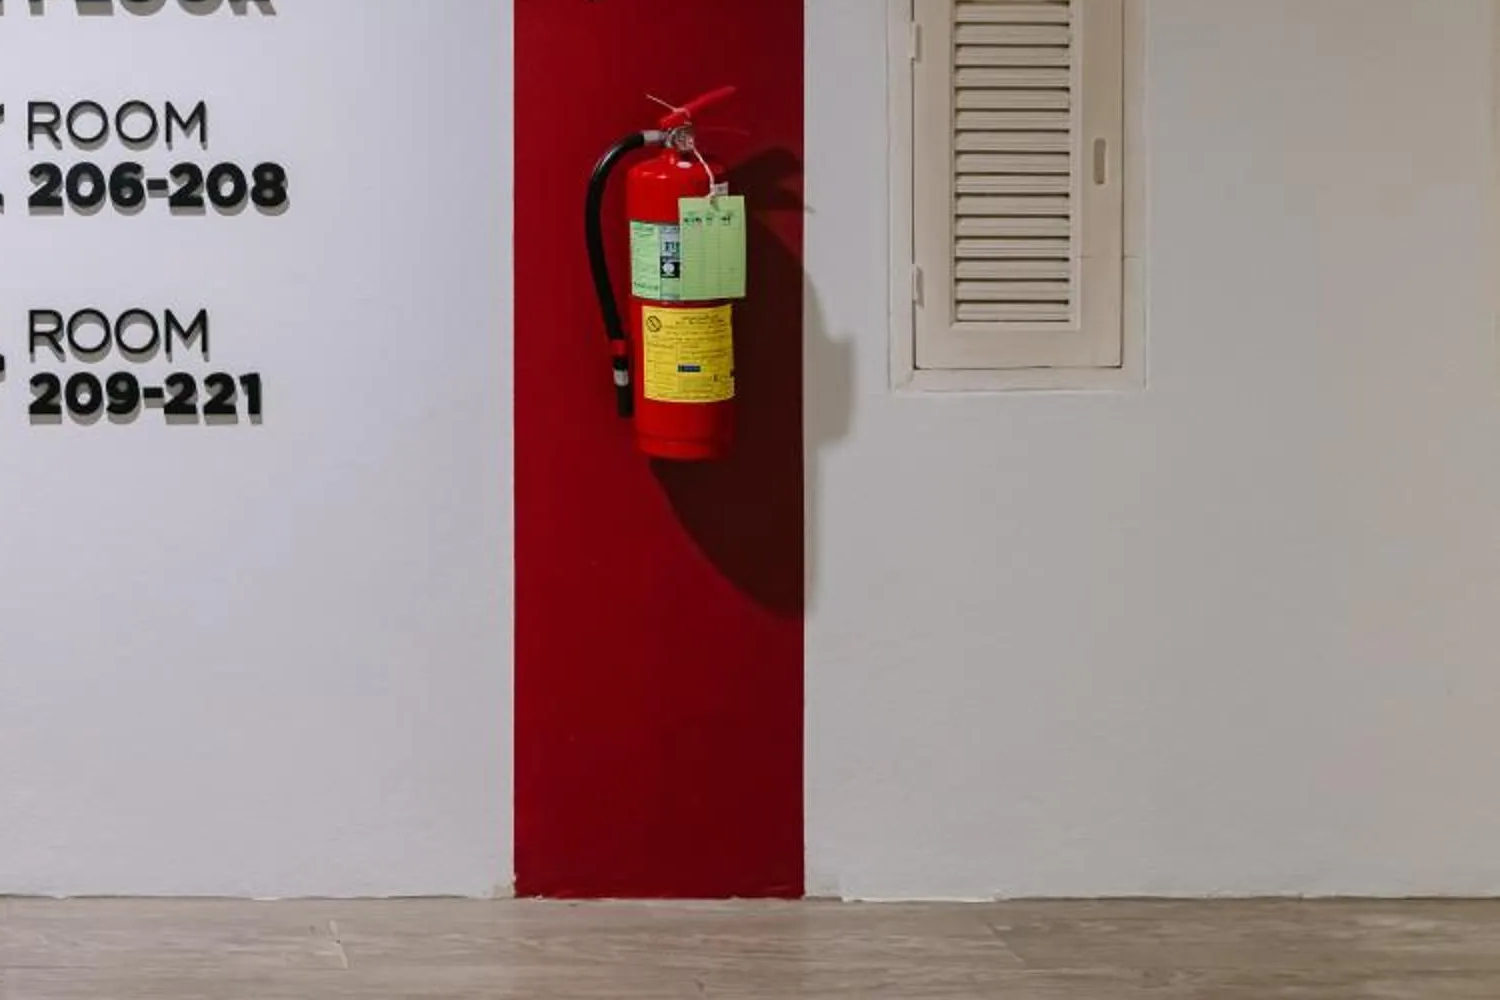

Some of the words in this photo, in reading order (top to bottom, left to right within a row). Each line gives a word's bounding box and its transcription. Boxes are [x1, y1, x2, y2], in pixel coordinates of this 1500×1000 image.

[28, 100, 207, 145] ROOM
[28, 162, 288, 210] 206-208
[28, 308, 209, 355] ROOM
[28, 371, 262, 418] 209-221
